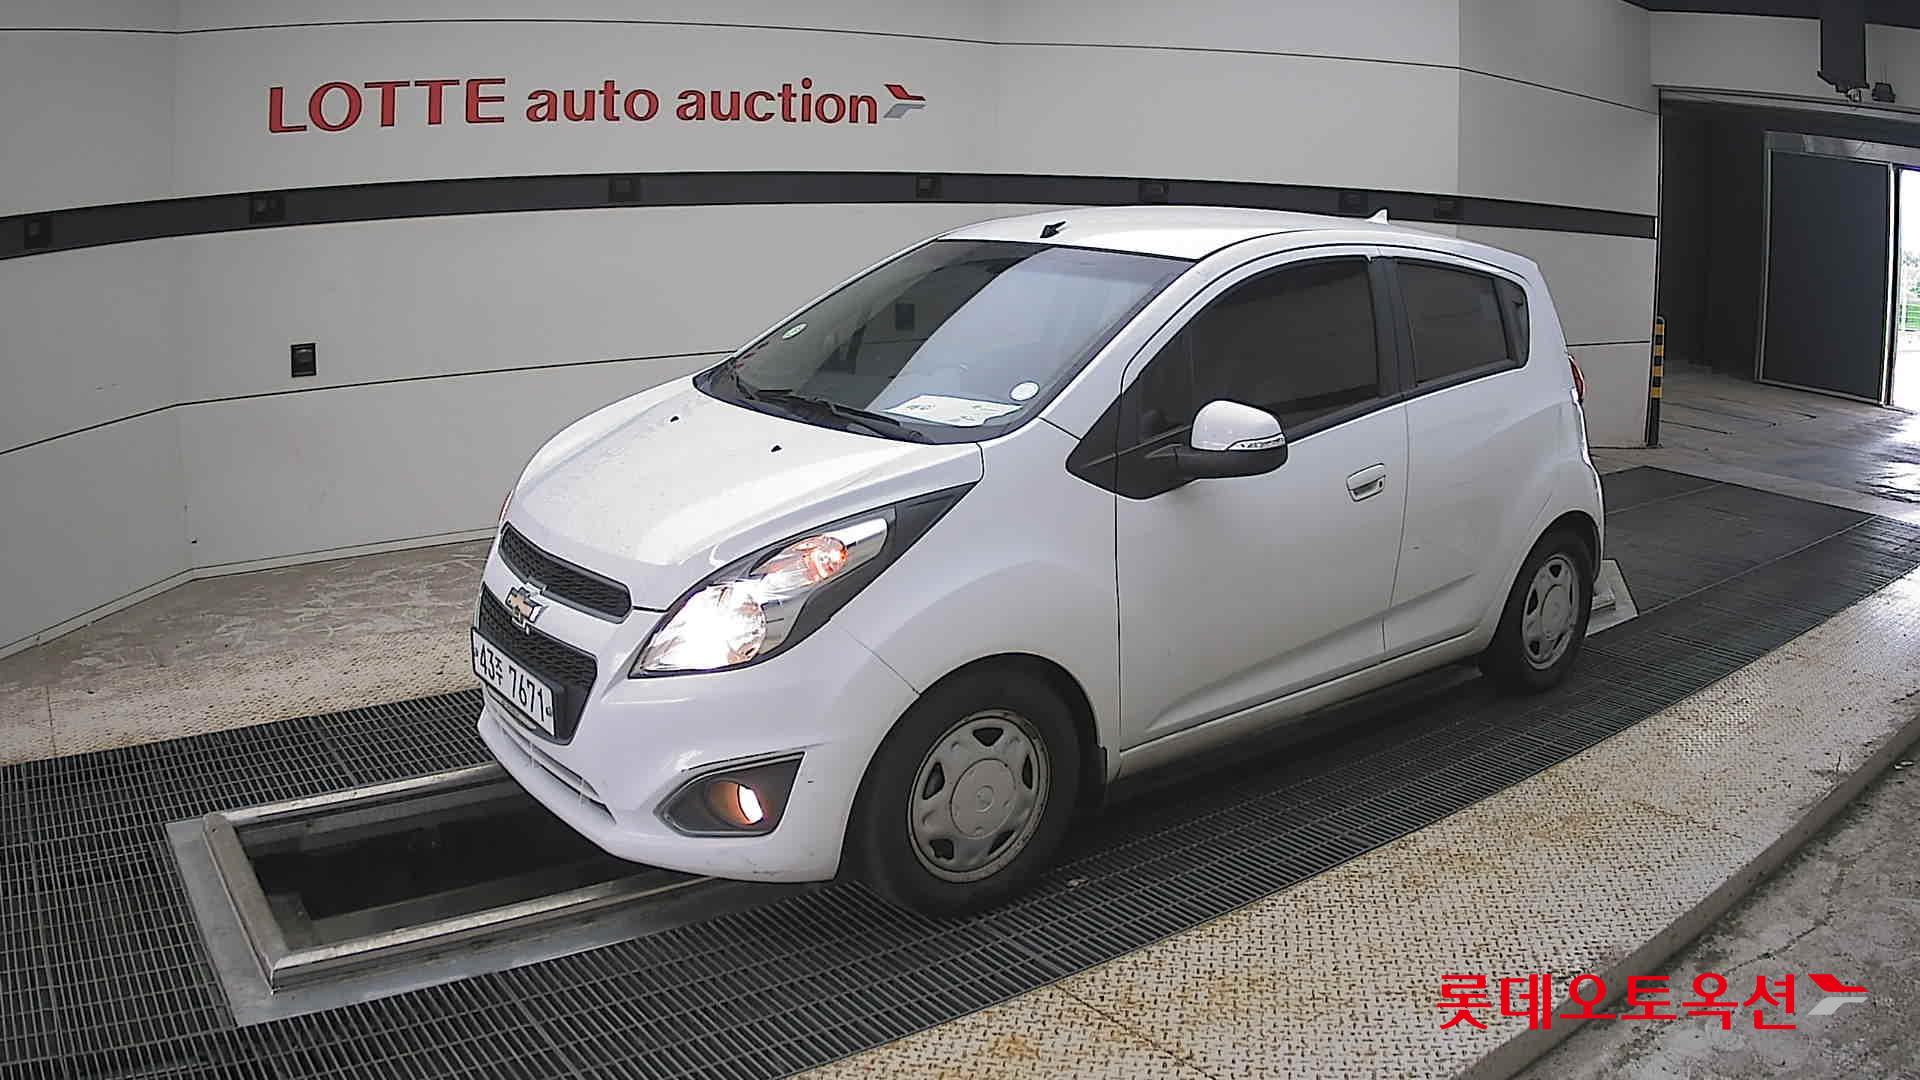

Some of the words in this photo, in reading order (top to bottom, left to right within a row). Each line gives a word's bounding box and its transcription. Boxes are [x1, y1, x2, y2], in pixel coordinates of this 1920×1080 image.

[268, 78, 505, 133] LOTTE
[526, 80, 659, 122] auto
[676, 78, 878, 124] auction
[508, 665, 545, 722] 7671
